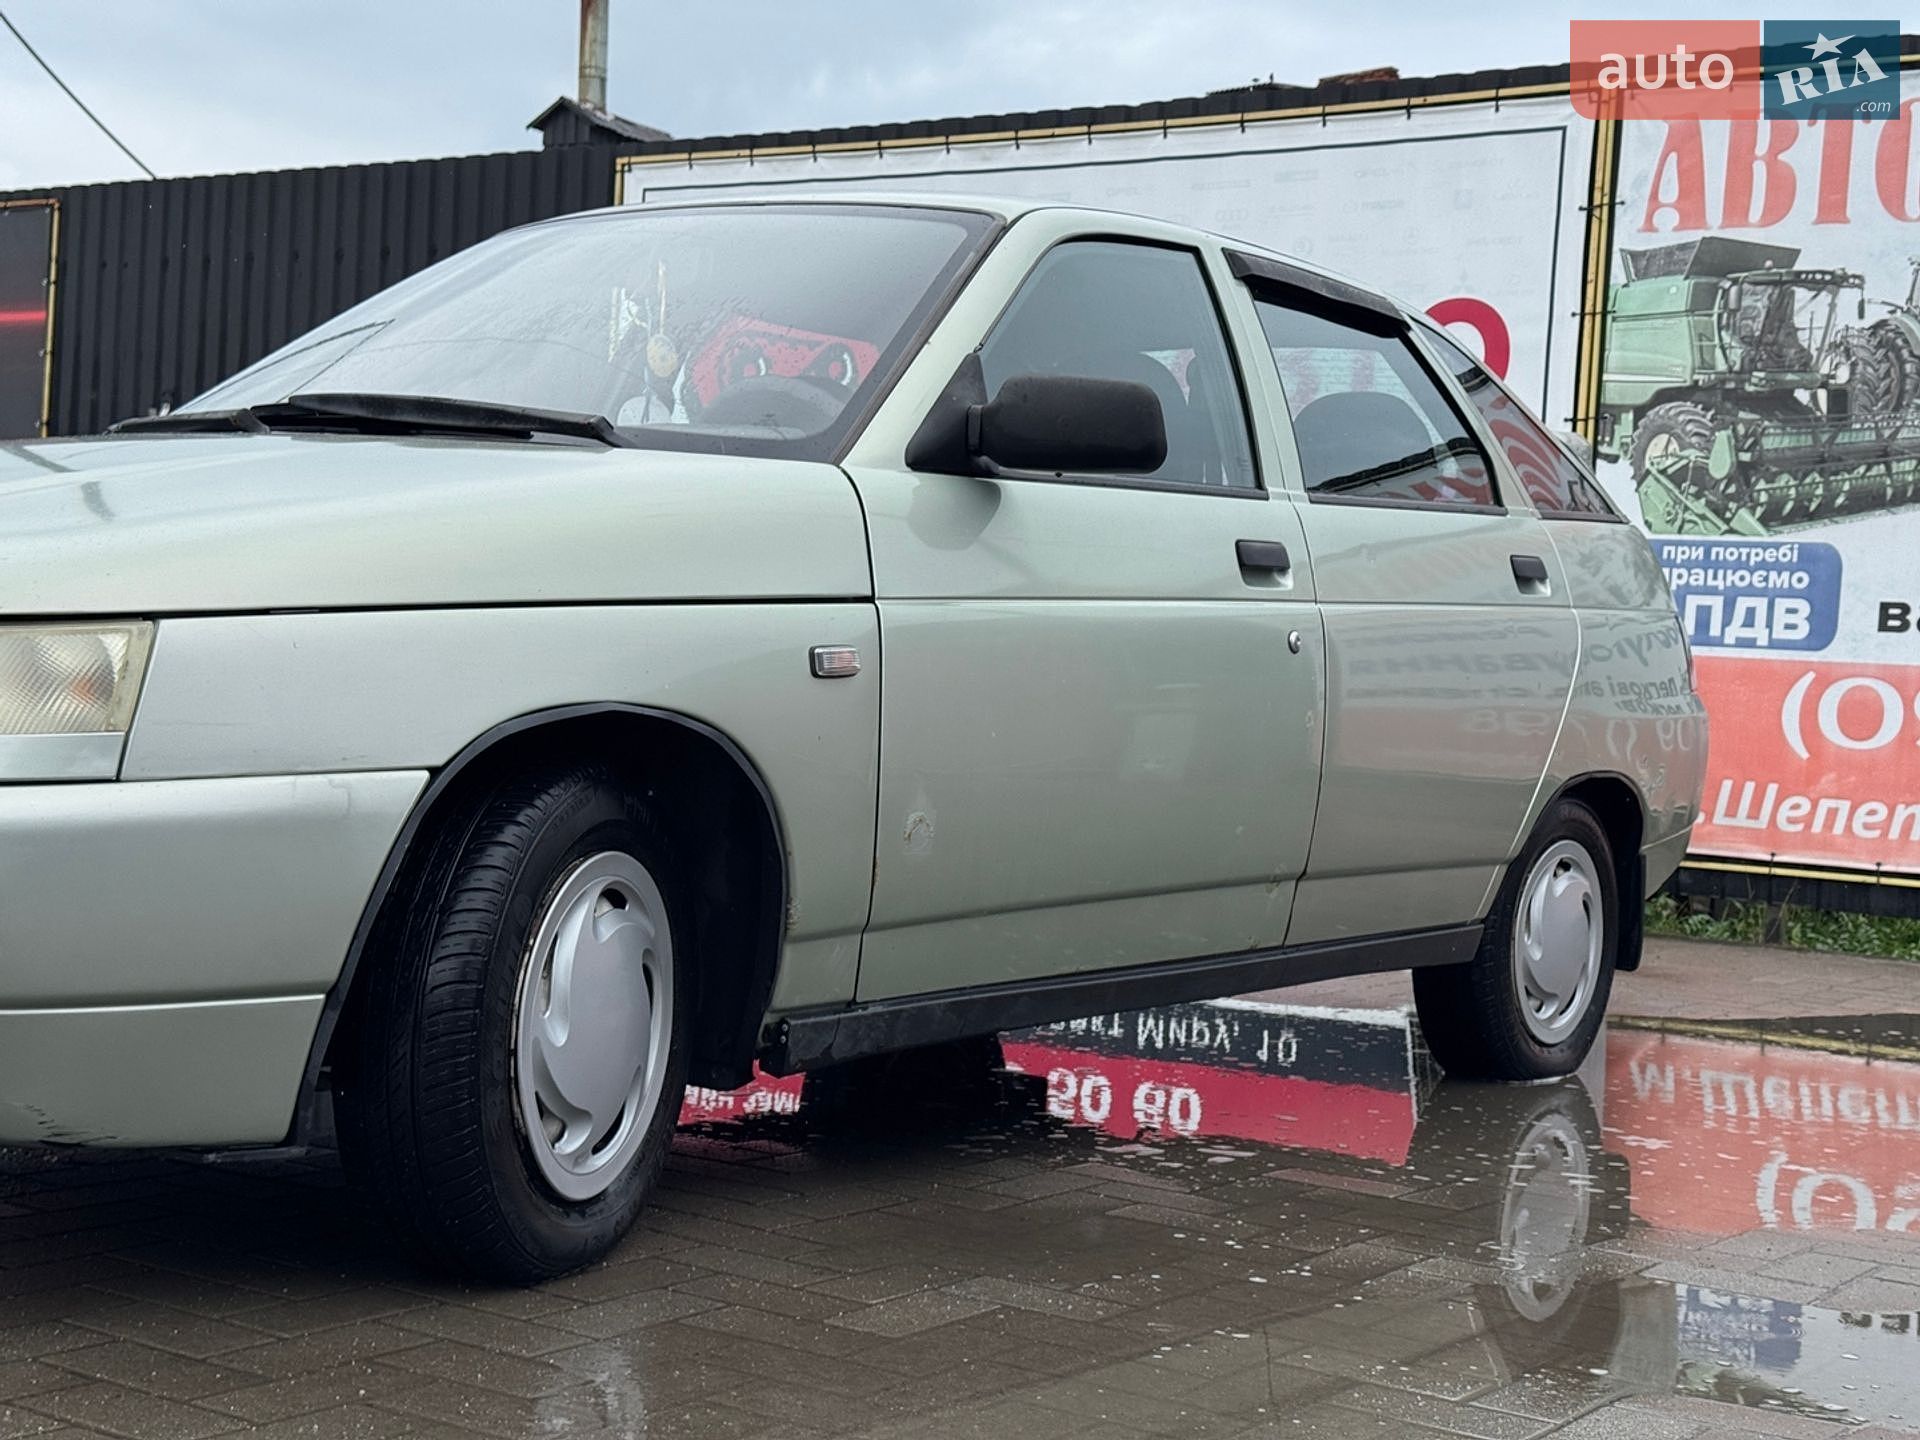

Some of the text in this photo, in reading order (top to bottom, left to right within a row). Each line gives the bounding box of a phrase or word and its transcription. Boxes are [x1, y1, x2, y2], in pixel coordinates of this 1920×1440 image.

[1662, 543, 1799, 566] при потребі
[1684, 594, 1811, 646] ПДВ
